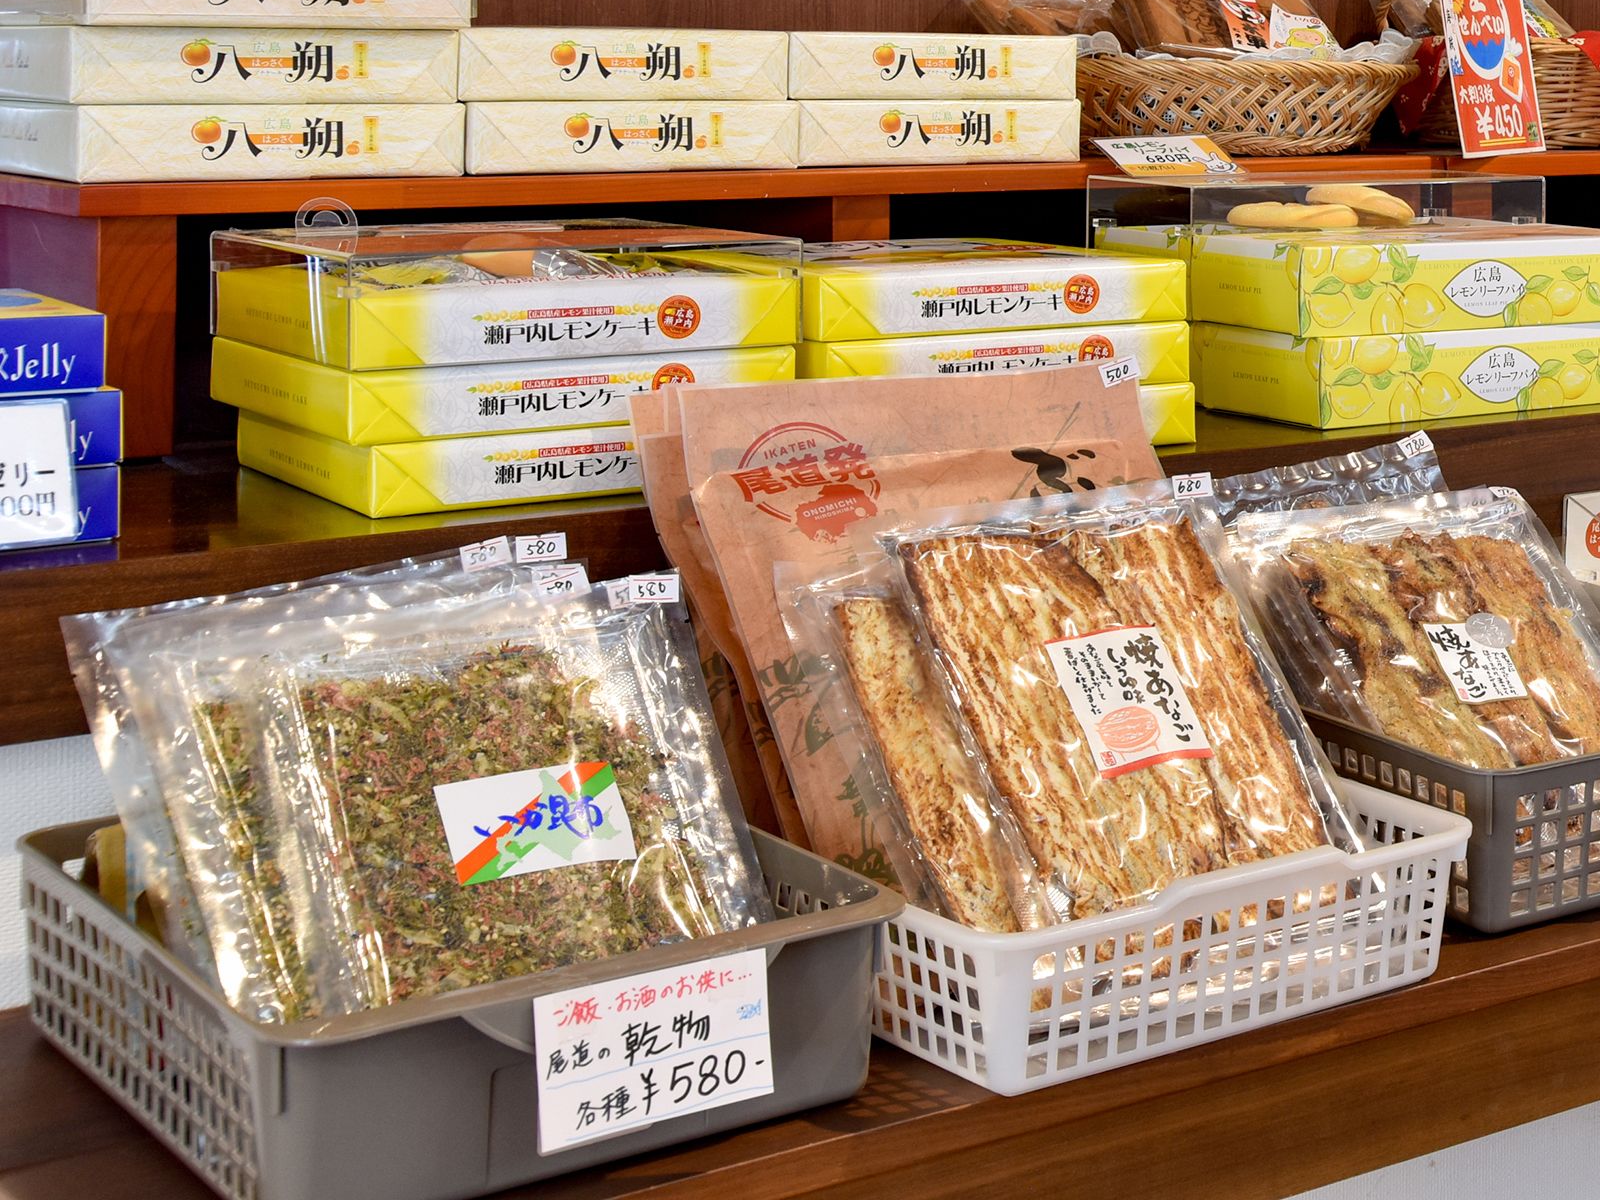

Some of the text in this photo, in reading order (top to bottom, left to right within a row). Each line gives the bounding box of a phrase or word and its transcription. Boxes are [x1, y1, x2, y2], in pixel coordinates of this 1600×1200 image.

[1458, 15, 1504, 36] せんべい
[191, 40, 333, 83] 八朔
[251, 57, 284, 68] はっさく
[559, 42, 681, 82] 八朔
[610, 57, 640, 68] はっさく
[880, 44, 986, 81] 八朔
[924, 58, 950, 68] はっさく
[886, 110, 992, 149] 八朔
[930, 124, 956, 133] はっさく
[1474, 102, 1525, 141] ¥450
[201, 117, 344, 161] 八朔
[262, 134, 295, 145] はっさく
[572, 113, 693, 154] 八朔
[623, 129, 651, 139] はっさく
[1145, 153, 1192, 164] 680円
[1473, 265, 1502, 284] 広島
[1450, 282, 1528, 301] レモンリーフパイ
[920, 293, 1063, 318] 瀬戸内レモンケーキ
[483, 320, 656, 346] 瀬戸内レモンケーキ
[1488, 351, 1516, 369] 広島
[1105, 364, 1130, 383] 500
[1465, 367, 1540, 387] レモンリーフパイ
[763, 438, 817, 460] IKATEN
[1405, 437, 1426, 454] 780
[730, 442, 876, 503] 尾道発
[1176, 477, 1203, 494] 680
[802, 497, 857, 518] ONOMICHI
[526, 540, 556, 556] 580
[637, 581, 667, 598] 580
[1427, 624, 1487, 699] 焼あなご
[1107, 647, 1146, 704] しょうゆ味
[1123, 633, 1194, 743] 焼あなご
[472, 794, 603, 840] いか昆布
[620, 1011, 711, 1061] 乾物
[575, 1086, 636, 1131] 各種
